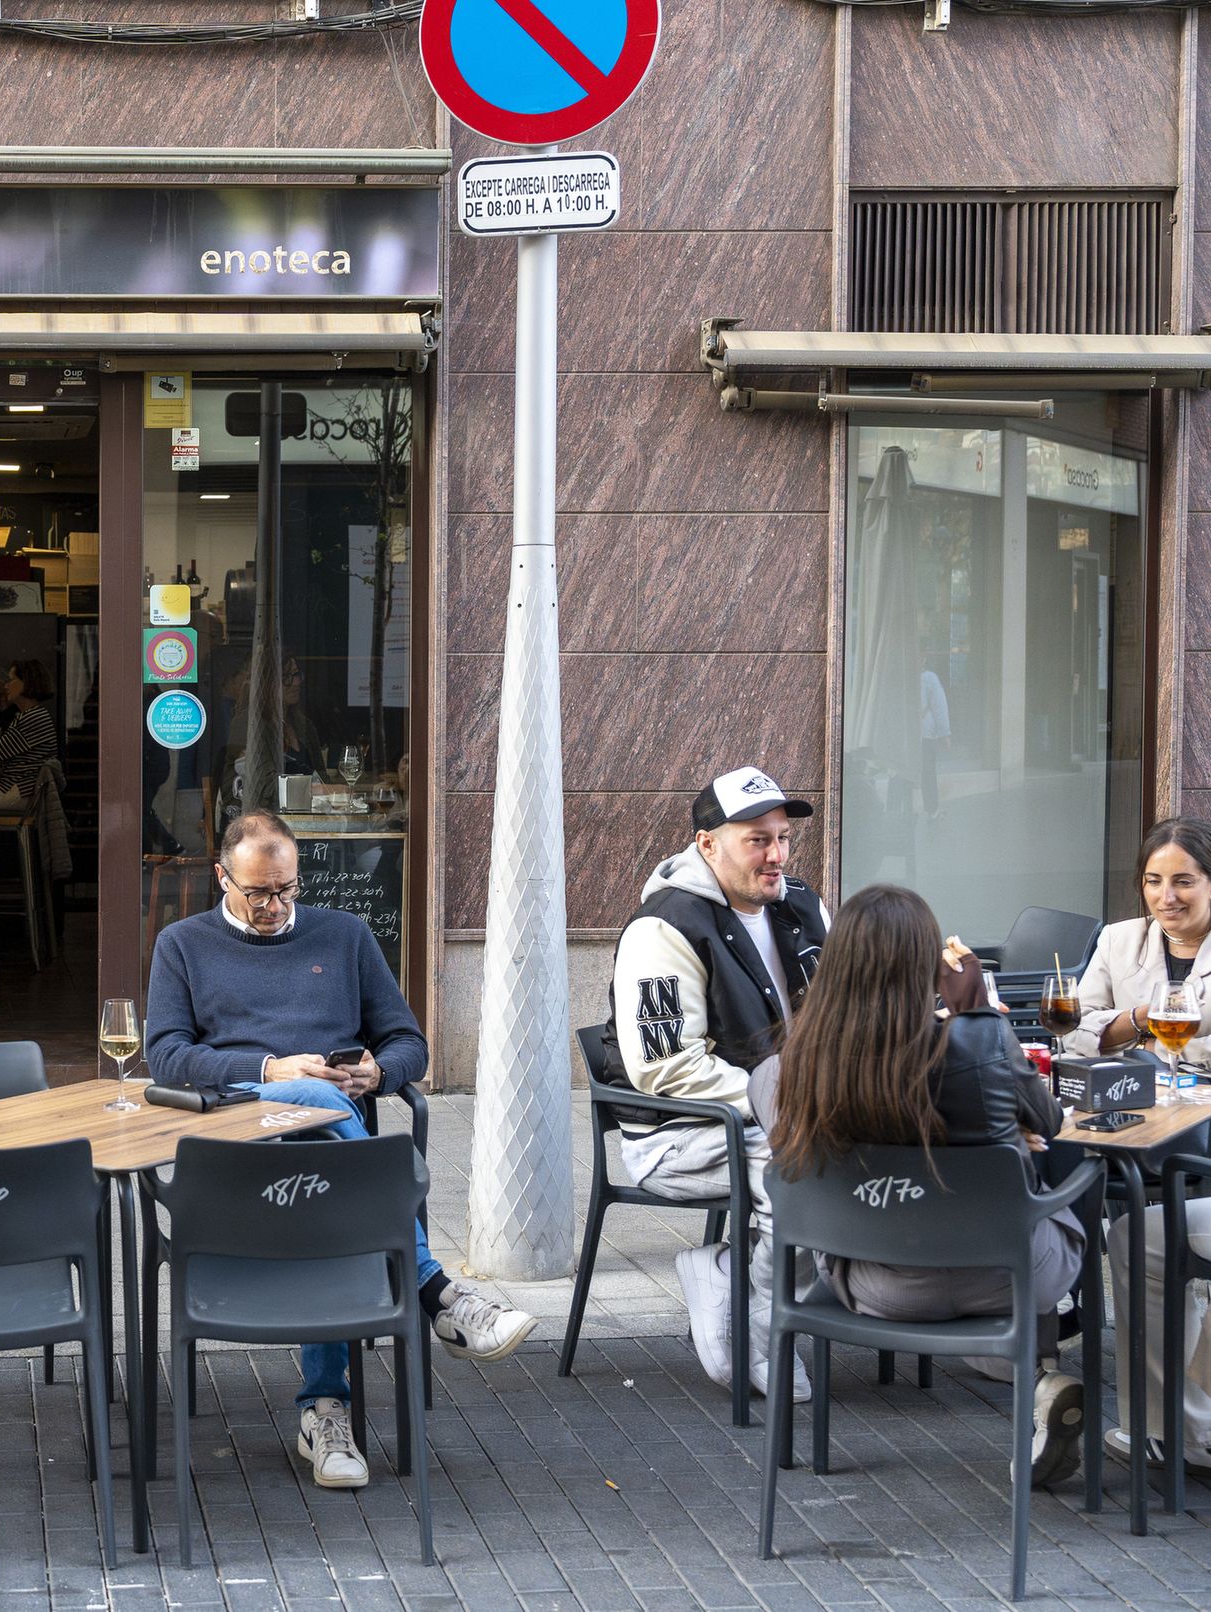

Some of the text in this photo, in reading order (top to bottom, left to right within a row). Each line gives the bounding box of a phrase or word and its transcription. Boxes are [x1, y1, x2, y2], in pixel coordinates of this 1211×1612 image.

[465, 172, 611, 198] EXCEPTE CARREGA I DESCARREGA
[465, 193, 608, 218] DE 08:00 H. A 10:00 H.
[200, 245, 351, 275] enoteca
[1106, 1075, 1141, 1101] 18/70
[260, 1173, 331, 1207] 18/70
[852, 1175, 926, 1209] 18/70
